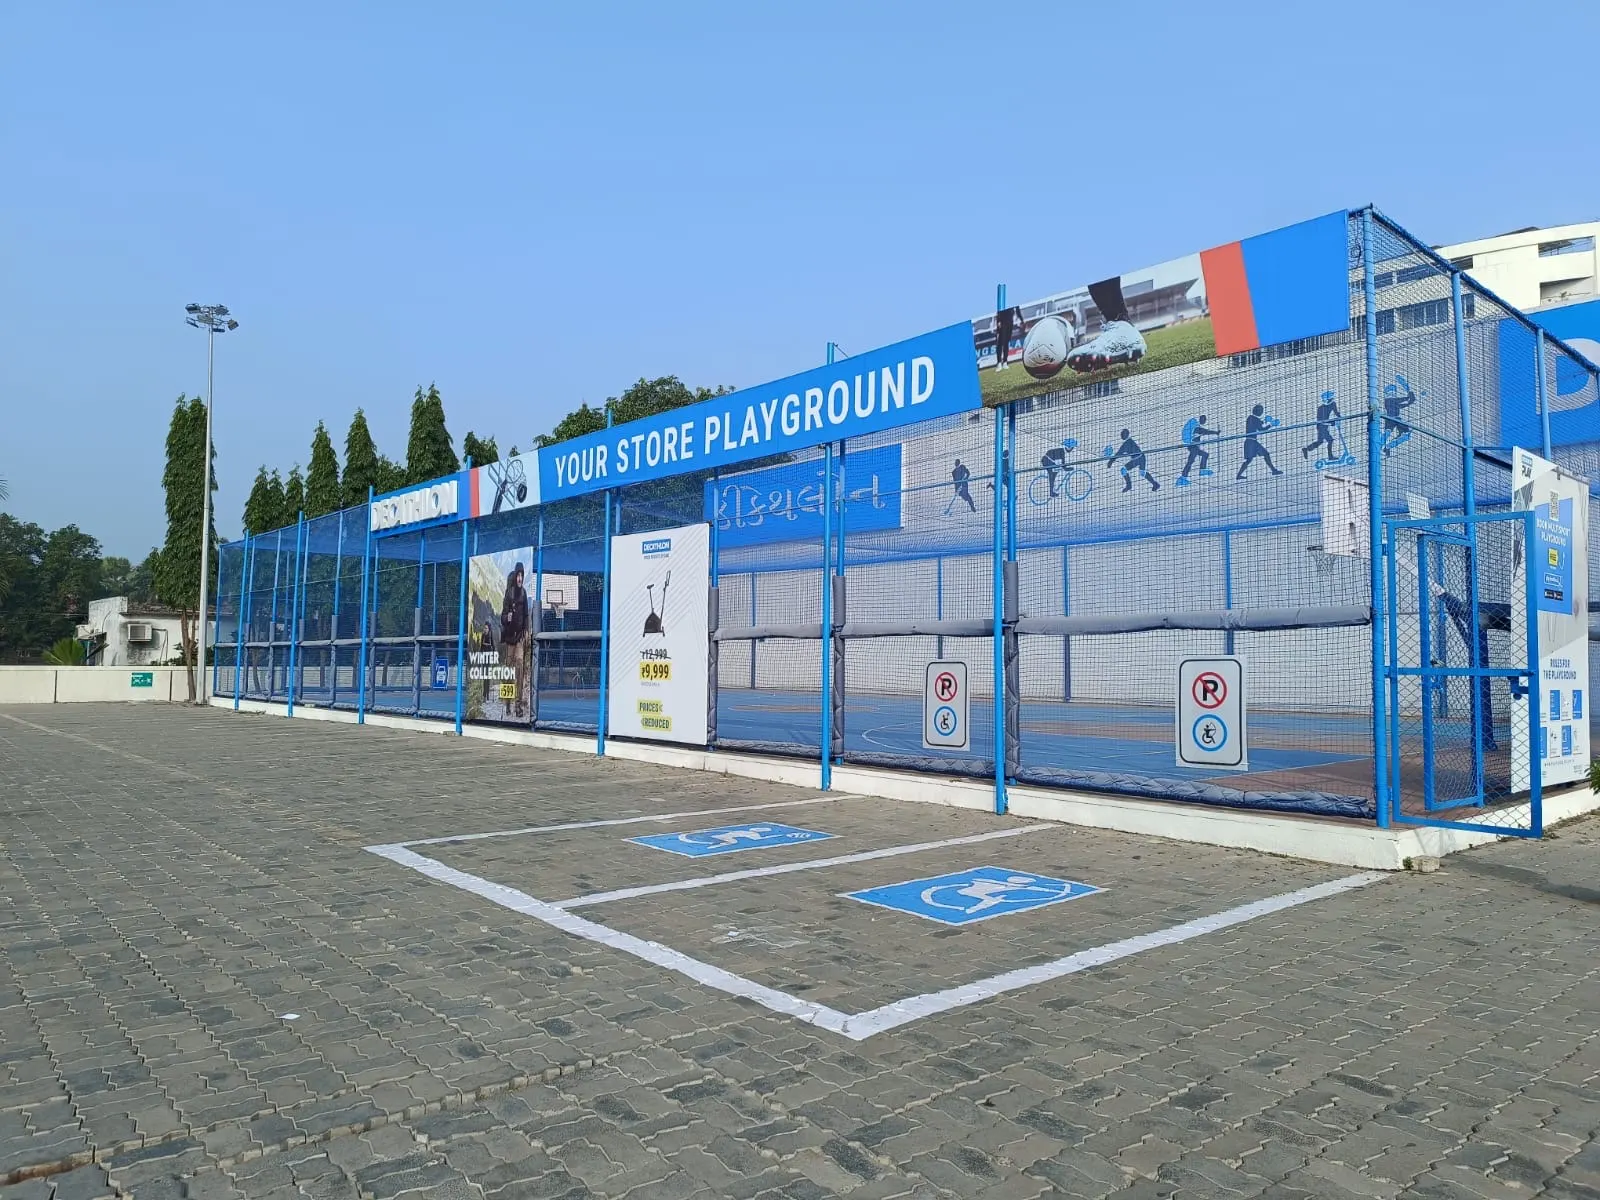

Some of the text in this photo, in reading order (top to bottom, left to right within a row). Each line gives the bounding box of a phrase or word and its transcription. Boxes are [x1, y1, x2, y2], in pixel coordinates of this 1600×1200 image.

[555, 356, 935, 488] YOUR STORE PLAYGROUND
[370, 480, 458, 531] DECATHLON
[643, 541, 670, 551] DECATHLON
[469, 651, 499, 664] WINTER
[469, 666, 516, 680] COLLECTION
[641, 663, 669, 680] ₹9,999
[1543, 670, 1577, 680] THE PLAYGROUND
[941, 678, 952, 696] P
[1201, 679, 1219, 702] P
[639, 702, 659, 712] PRICES
[644, 717, 670, 729] REDUCED
